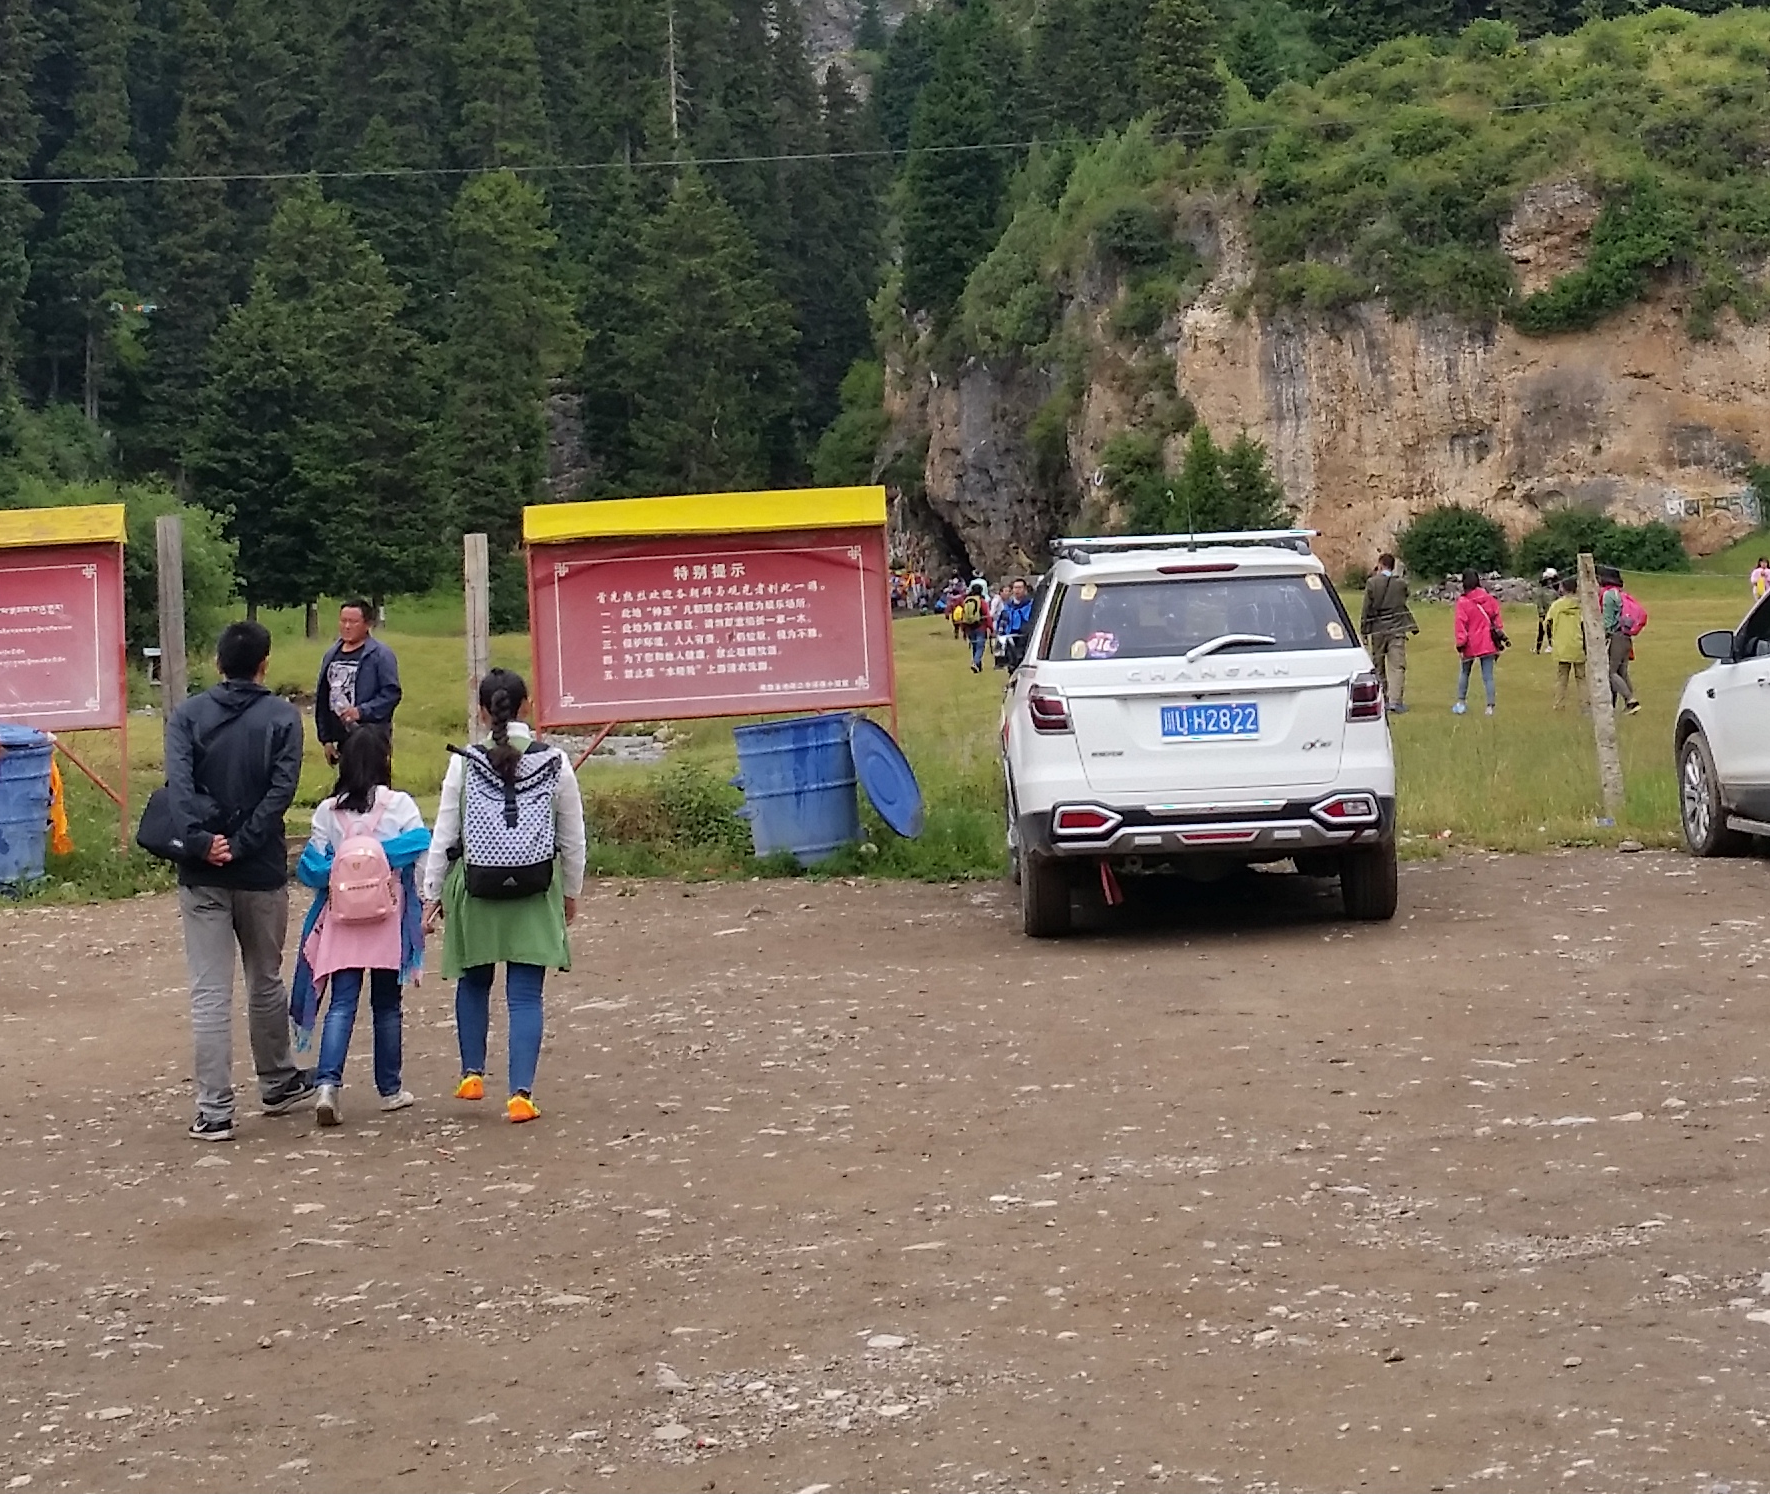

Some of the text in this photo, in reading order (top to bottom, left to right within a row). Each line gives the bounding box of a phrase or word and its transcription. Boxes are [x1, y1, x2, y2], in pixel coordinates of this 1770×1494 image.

[673, 562, 746, 581] 特别提示
[1127, 667, 1290, 682] CHANGAN
